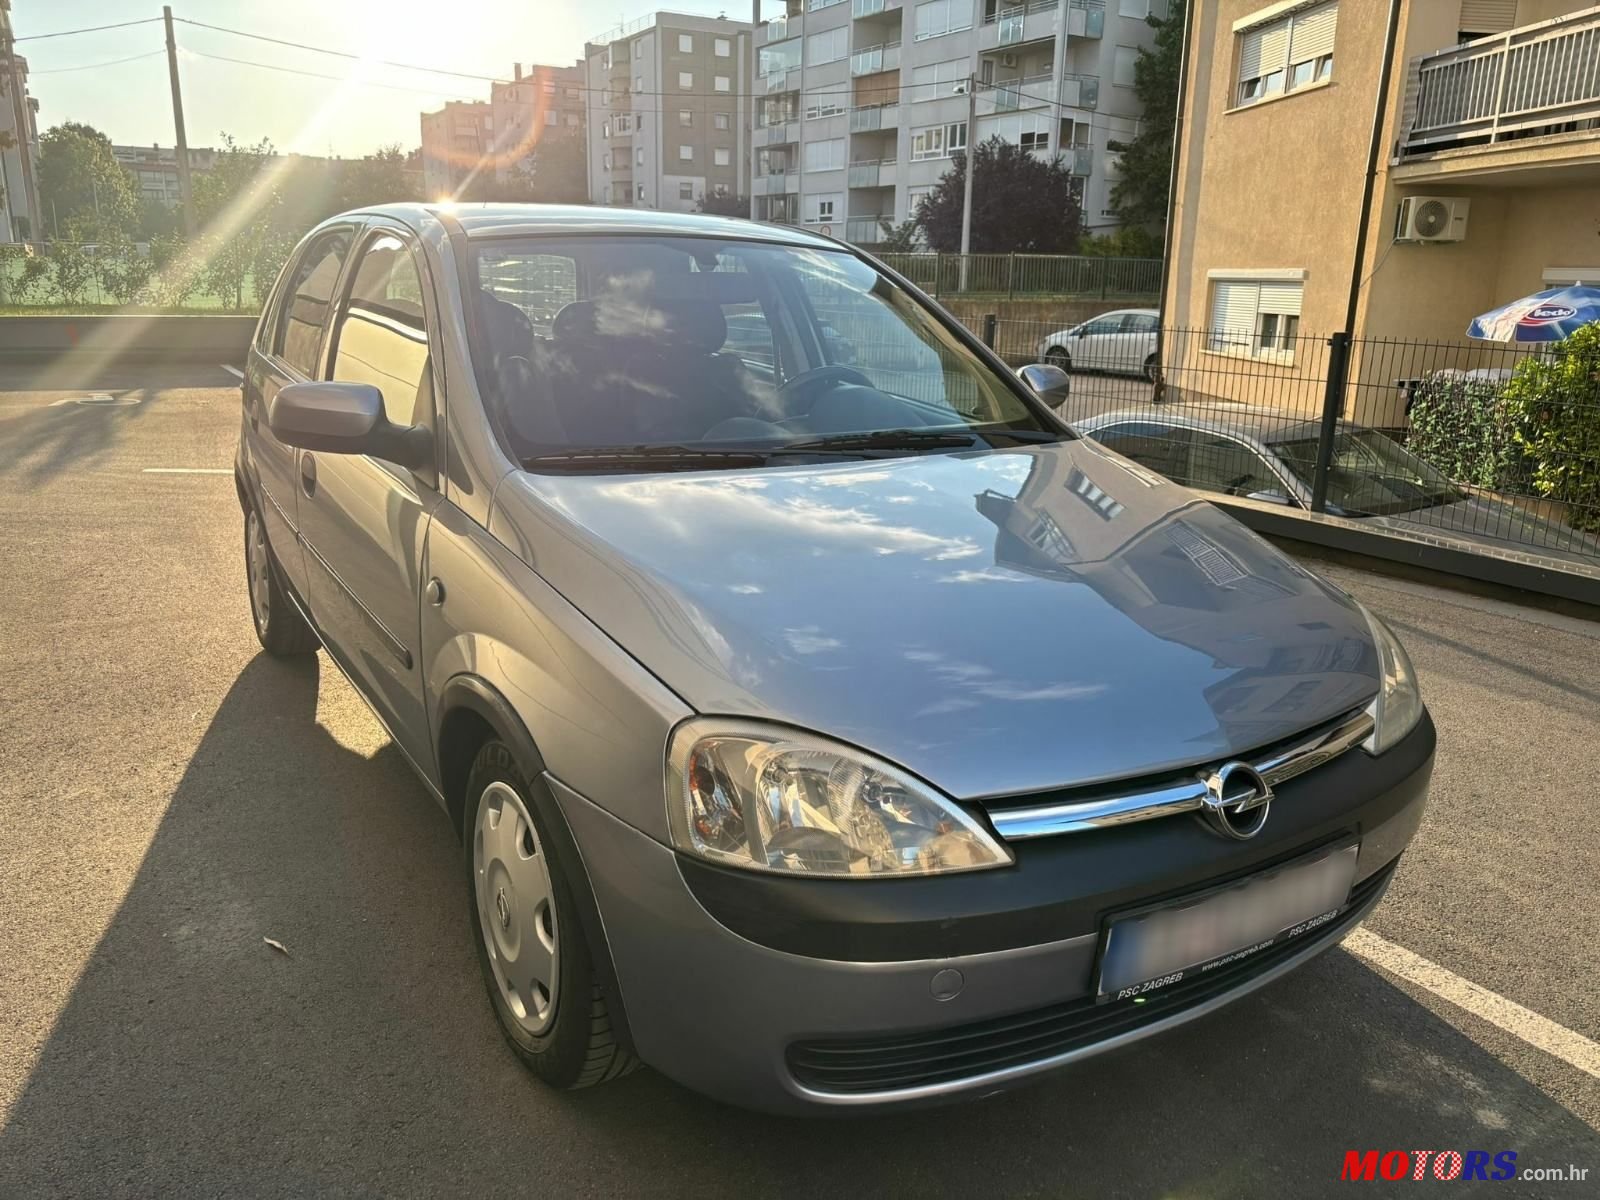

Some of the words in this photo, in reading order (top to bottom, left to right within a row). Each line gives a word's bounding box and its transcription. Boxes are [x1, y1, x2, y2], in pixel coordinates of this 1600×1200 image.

[1288, 923, 1306, 938] PSC
[1306, 909, 1338, 930] ZAGREB
[1117, 985, 1140, 1001] PSC
[1141, 972, 1184, 993] ZAGREB
